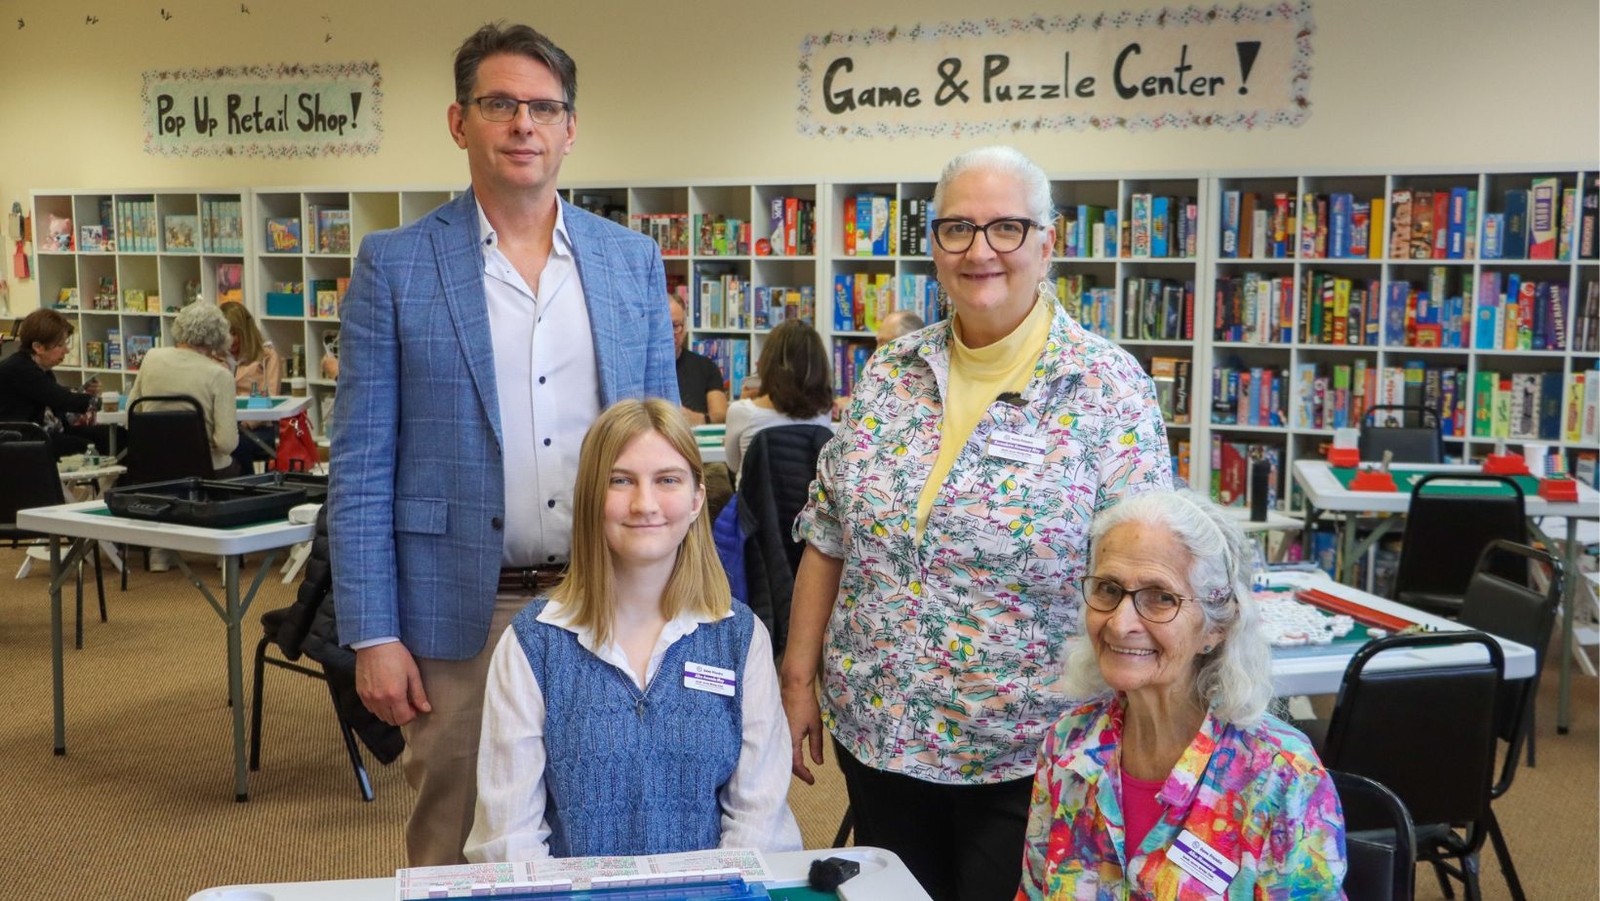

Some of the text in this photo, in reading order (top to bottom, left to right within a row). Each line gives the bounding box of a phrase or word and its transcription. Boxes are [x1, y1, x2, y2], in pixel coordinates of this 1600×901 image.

[823, 56, 921, 114] Game
[934, 57, 969, 106] &
[983, 52, 1095, 104] Puzzle
[156, 91, 362, 138] Pop Up Retail Shop!
[1549, 284, 1566, 348] BALDERDASH
